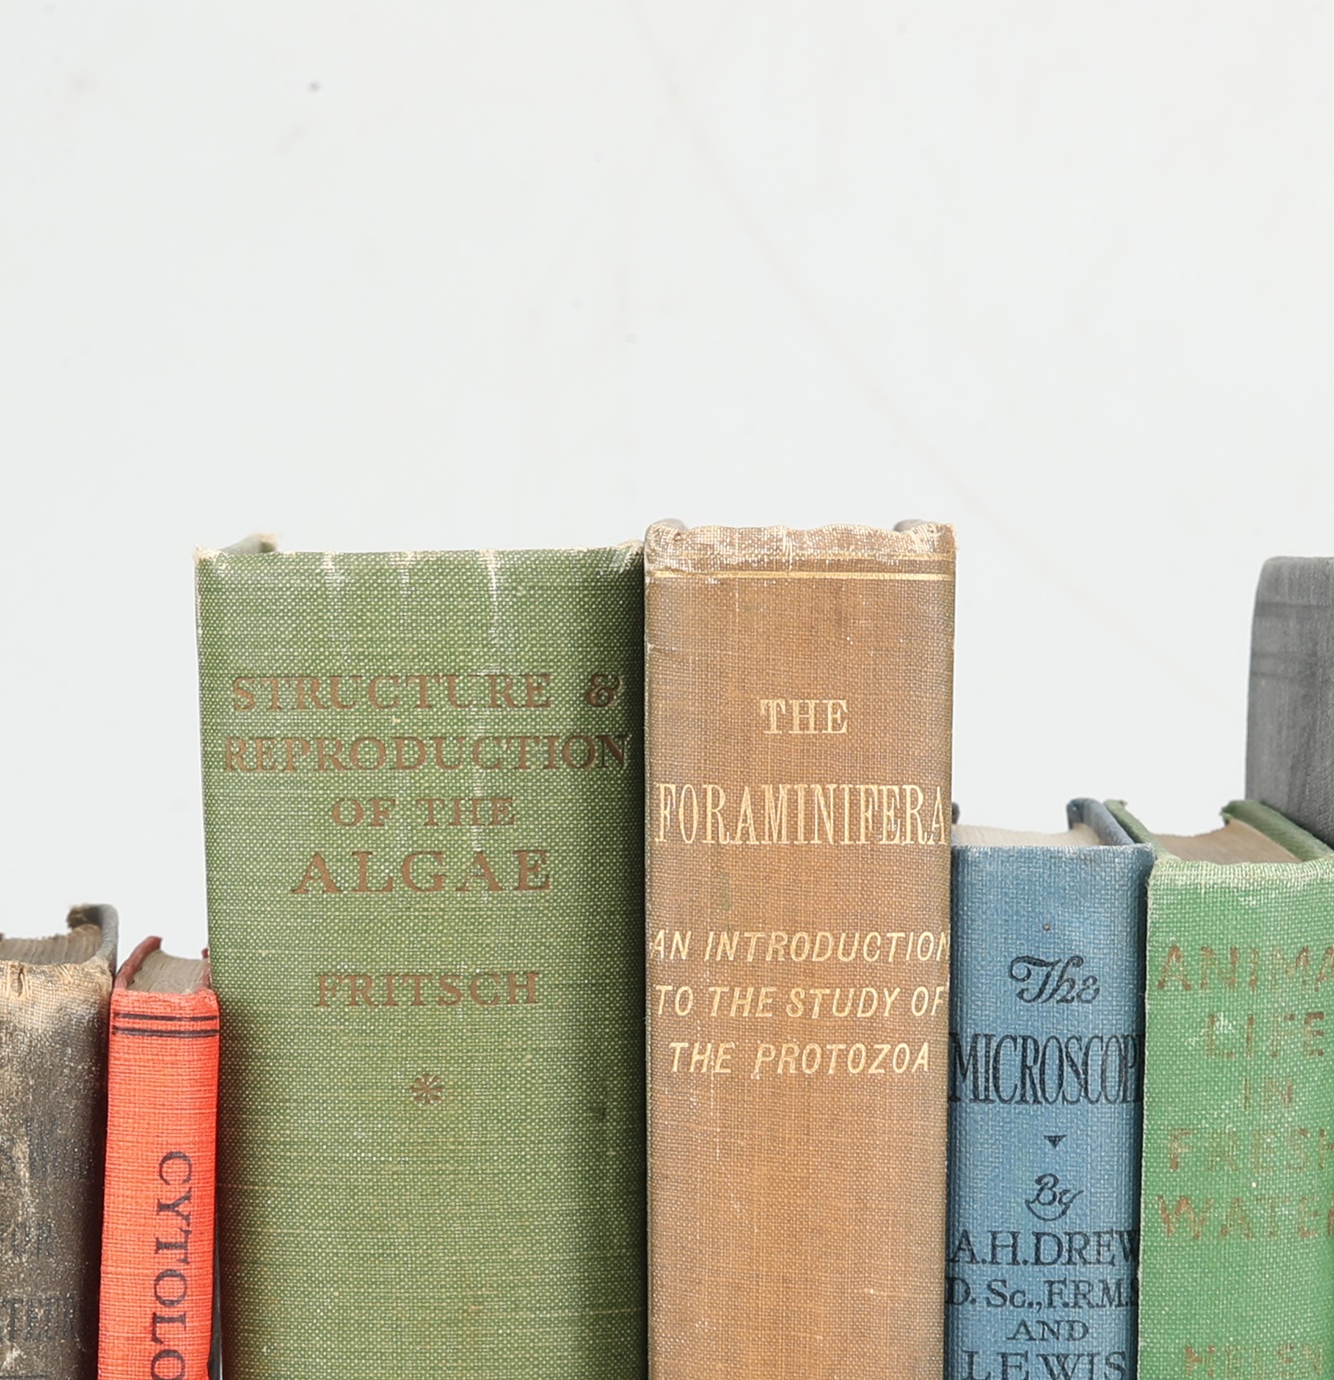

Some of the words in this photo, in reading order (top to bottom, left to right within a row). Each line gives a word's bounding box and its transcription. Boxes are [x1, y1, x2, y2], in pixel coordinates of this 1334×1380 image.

[233, 674, 551, 711] STRUCTURE
[585, 673, 621, 708] &
[760, 699, 848, 734] THE
[224, 734, 628, 772] REPRODUCTION
[331, 797, 396, 827] OF
[415, 797, 516, 826] THE
[654, 784, 948, 845] FORAMINIFERA
[291, 849, 551, 894] ALGAE
[651, 929, 691, 961] AN
[316, 972, 539, 1008] FRITSCH
[1009, 955, 1100, 1004] The
[656, 985, 694, 1016] TO
[709, 986, 774, 1018] THE
[786, 987, 901, 1019] STUDY
[911, 985, 945, 1016] OF
[669, 1041, 735, 1073] THE
[753, 1042, 930, 1078] PROTOZOA
[1025, 1173, 1084, 1221] By
[1007, 1319, 1089, 1342] AND
